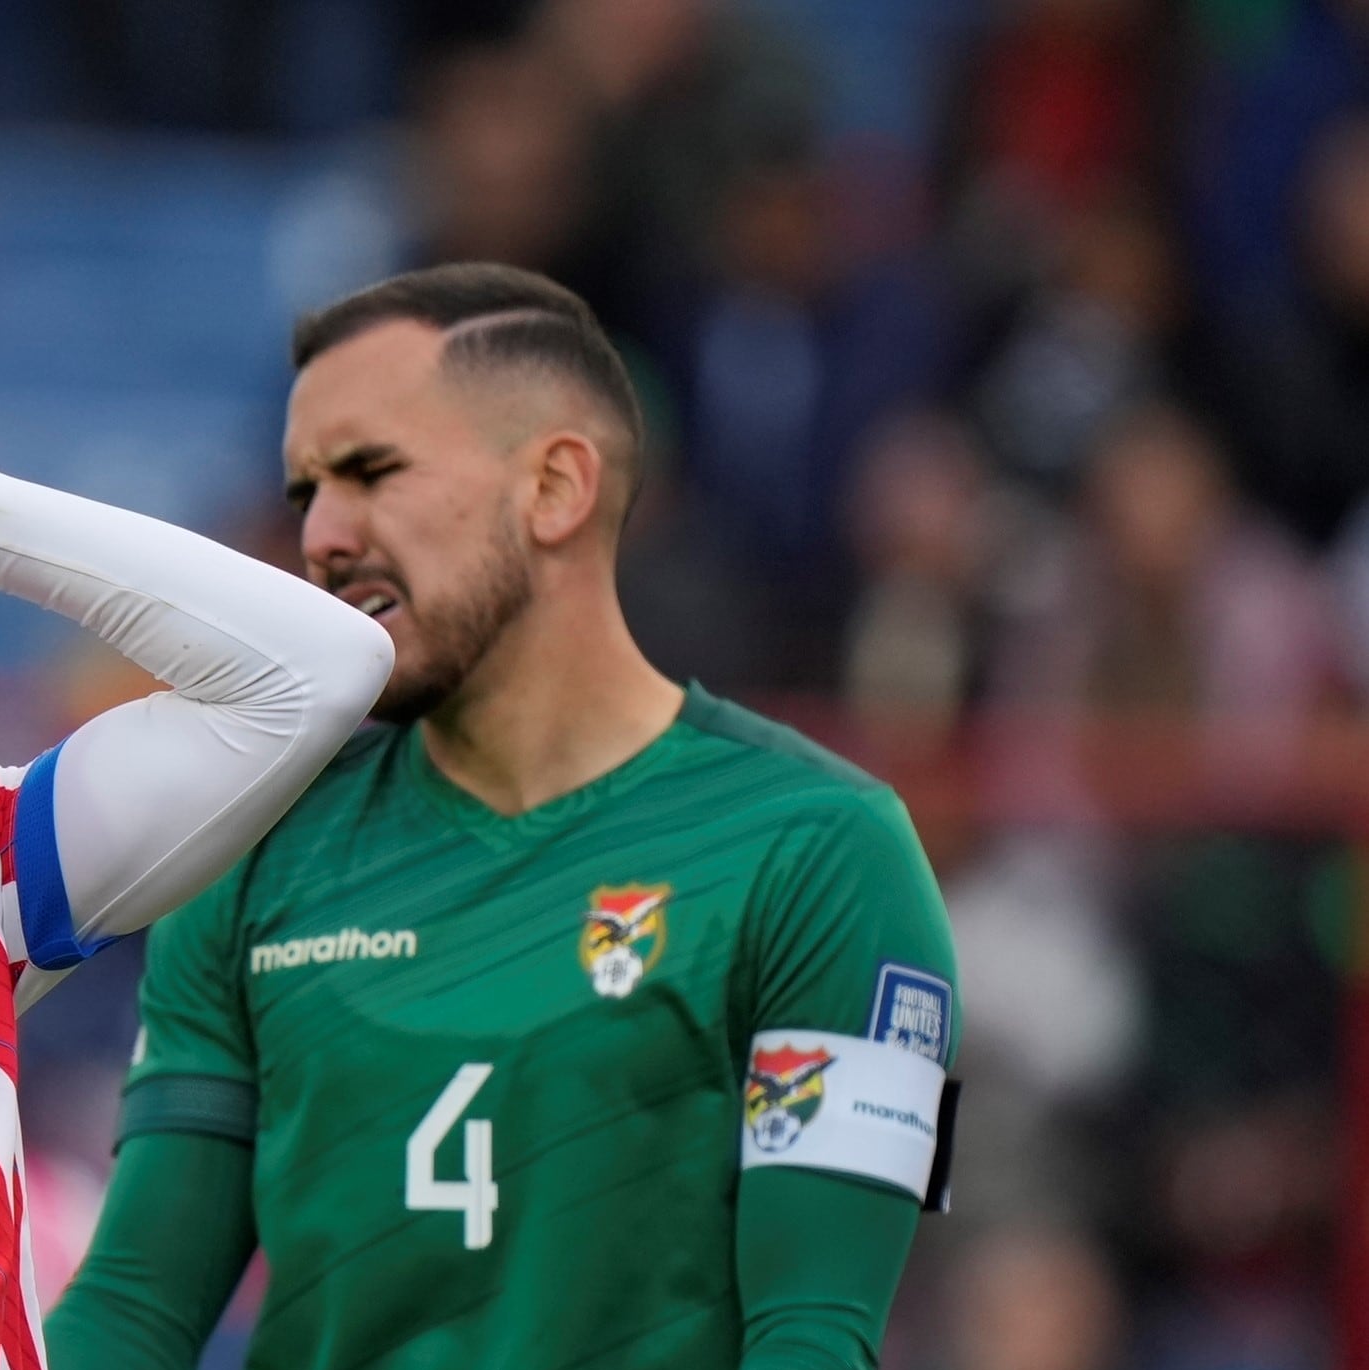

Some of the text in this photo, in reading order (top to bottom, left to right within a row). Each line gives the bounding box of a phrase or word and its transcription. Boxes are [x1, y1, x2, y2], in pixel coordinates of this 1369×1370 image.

[250, 928, 418, 975] marathon
[890, 1003, 942, 1040] UNITES
[404, 1062, 500, 1250] 4
